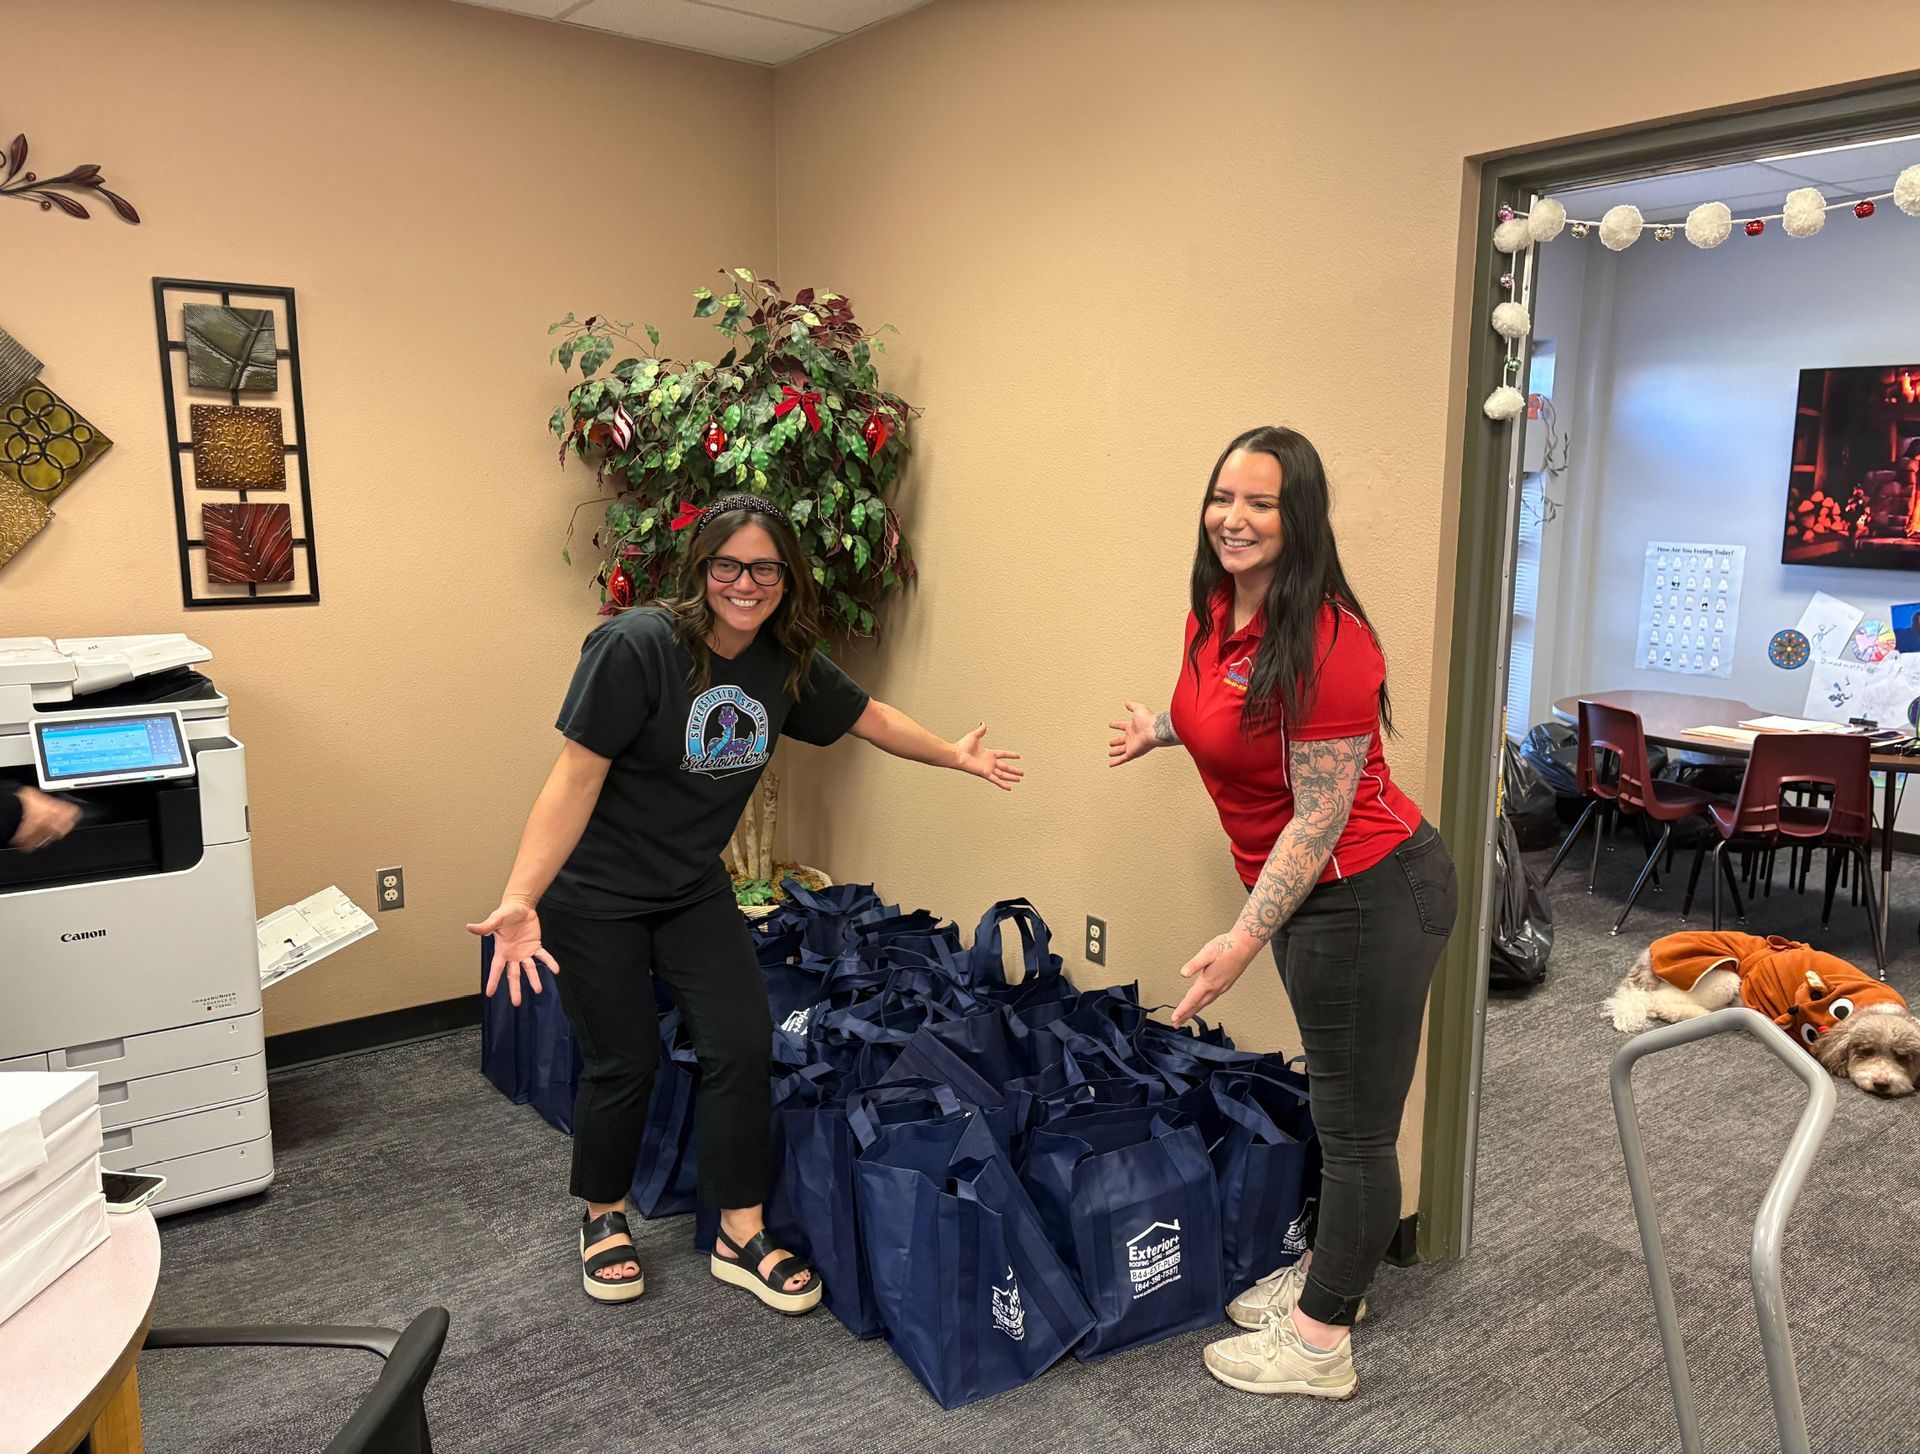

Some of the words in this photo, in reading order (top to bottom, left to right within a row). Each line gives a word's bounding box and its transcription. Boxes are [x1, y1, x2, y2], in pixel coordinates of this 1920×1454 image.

[1657, 546, 1670, 554] How
[1694, 548, 1713, 556] Feeling
[1714, 549, 1734, 557] Today?
[740, 697, 765, 737] SPRINGS
[681, 745, 766, 769] Sidewinders
[60, 929, 106, 943] Canon
[1129, 1235, 1179, 1261] Exterior+
[1132, 1254, 1180, 1280] 844-EXT-PLUS
